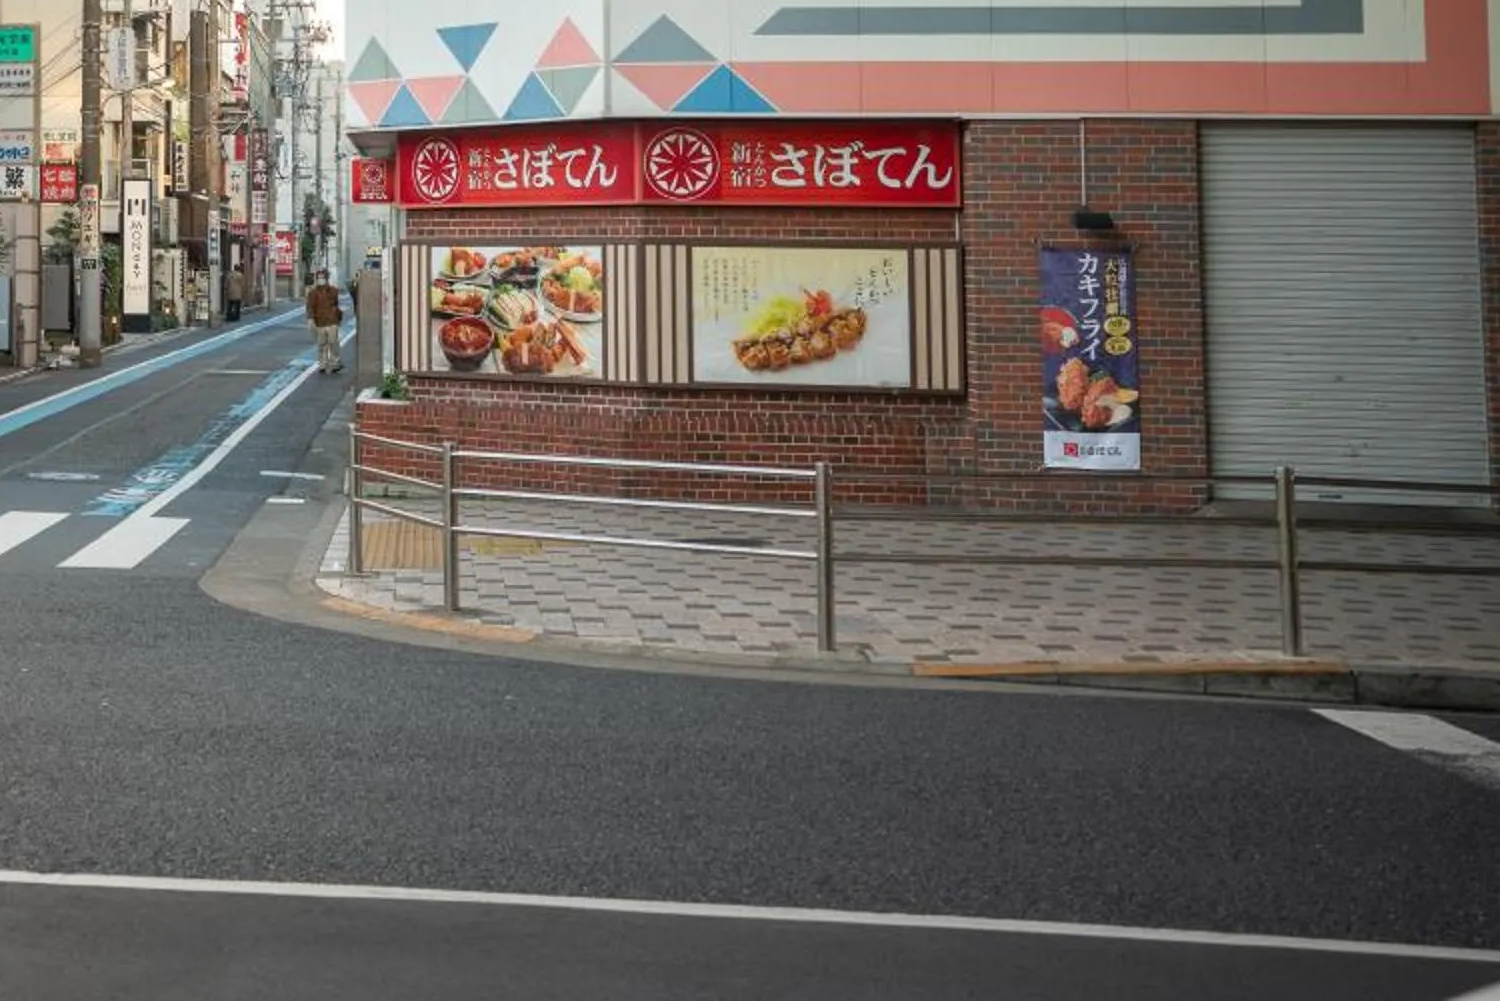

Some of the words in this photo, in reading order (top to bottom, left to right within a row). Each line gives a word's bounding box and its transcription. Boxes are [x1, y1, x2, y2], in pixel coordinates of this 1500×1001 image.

[493, 144, 617, 188] さぼてん
[771, 140, 953, 189] さぼてん
[1078, 253, 1100, 361] カキフライ
